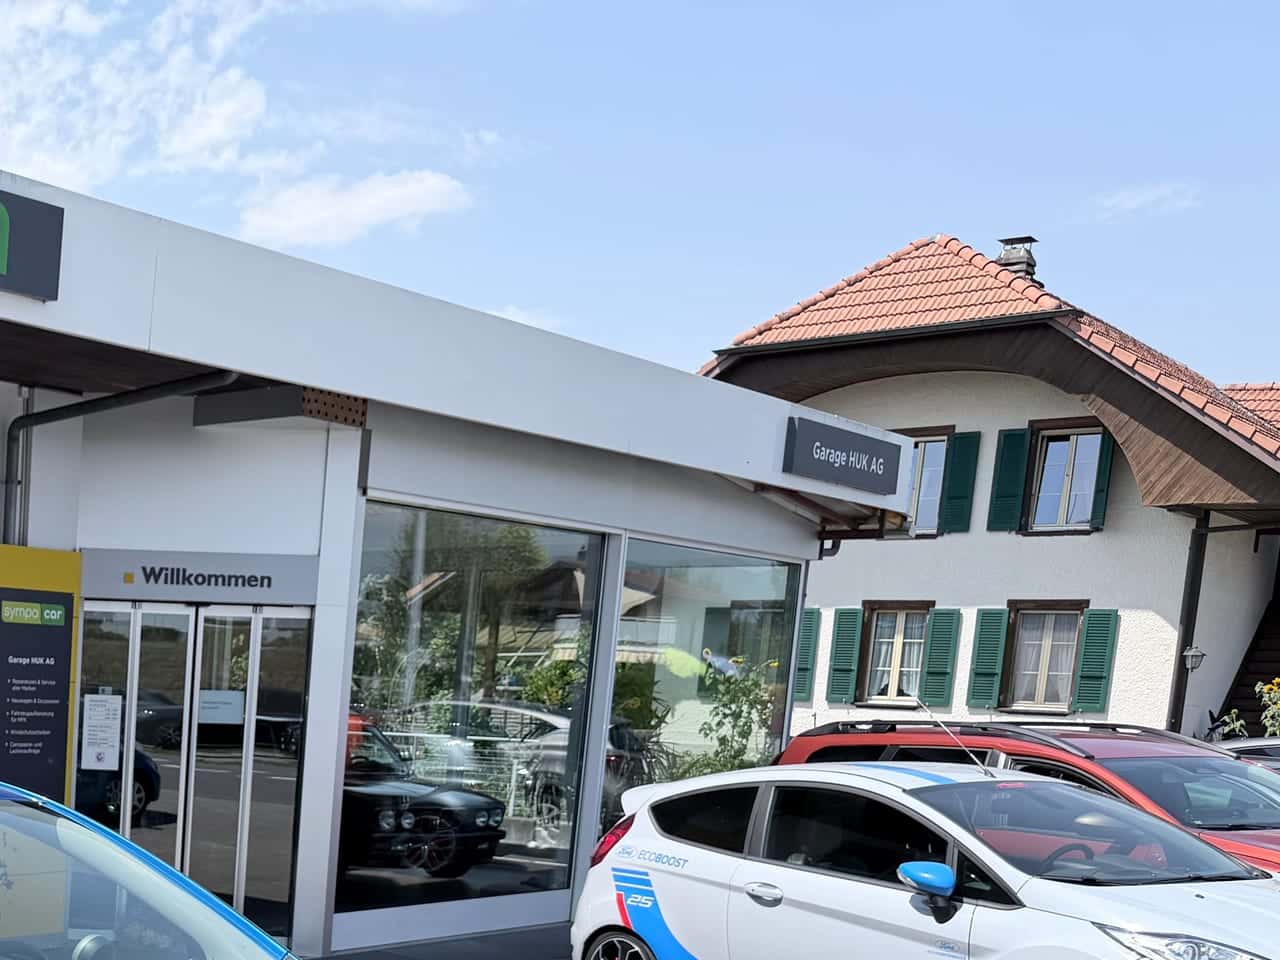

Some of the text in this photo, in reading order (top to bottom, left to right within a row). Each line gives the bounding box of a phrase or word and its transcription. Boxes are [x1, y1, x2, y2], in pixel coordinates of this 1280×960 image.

[812, 441, 884, 475] Garage HUK AG
[141, 566, 272, 588] Willkommen
[3, 606, 63, 620] sympa car
[7, 655, 30, 665] Garage
[45, 657, 56, 665] AG
[638, 849, 689, 869] ECOBOOST
[626, 894, 655, 908] 25
